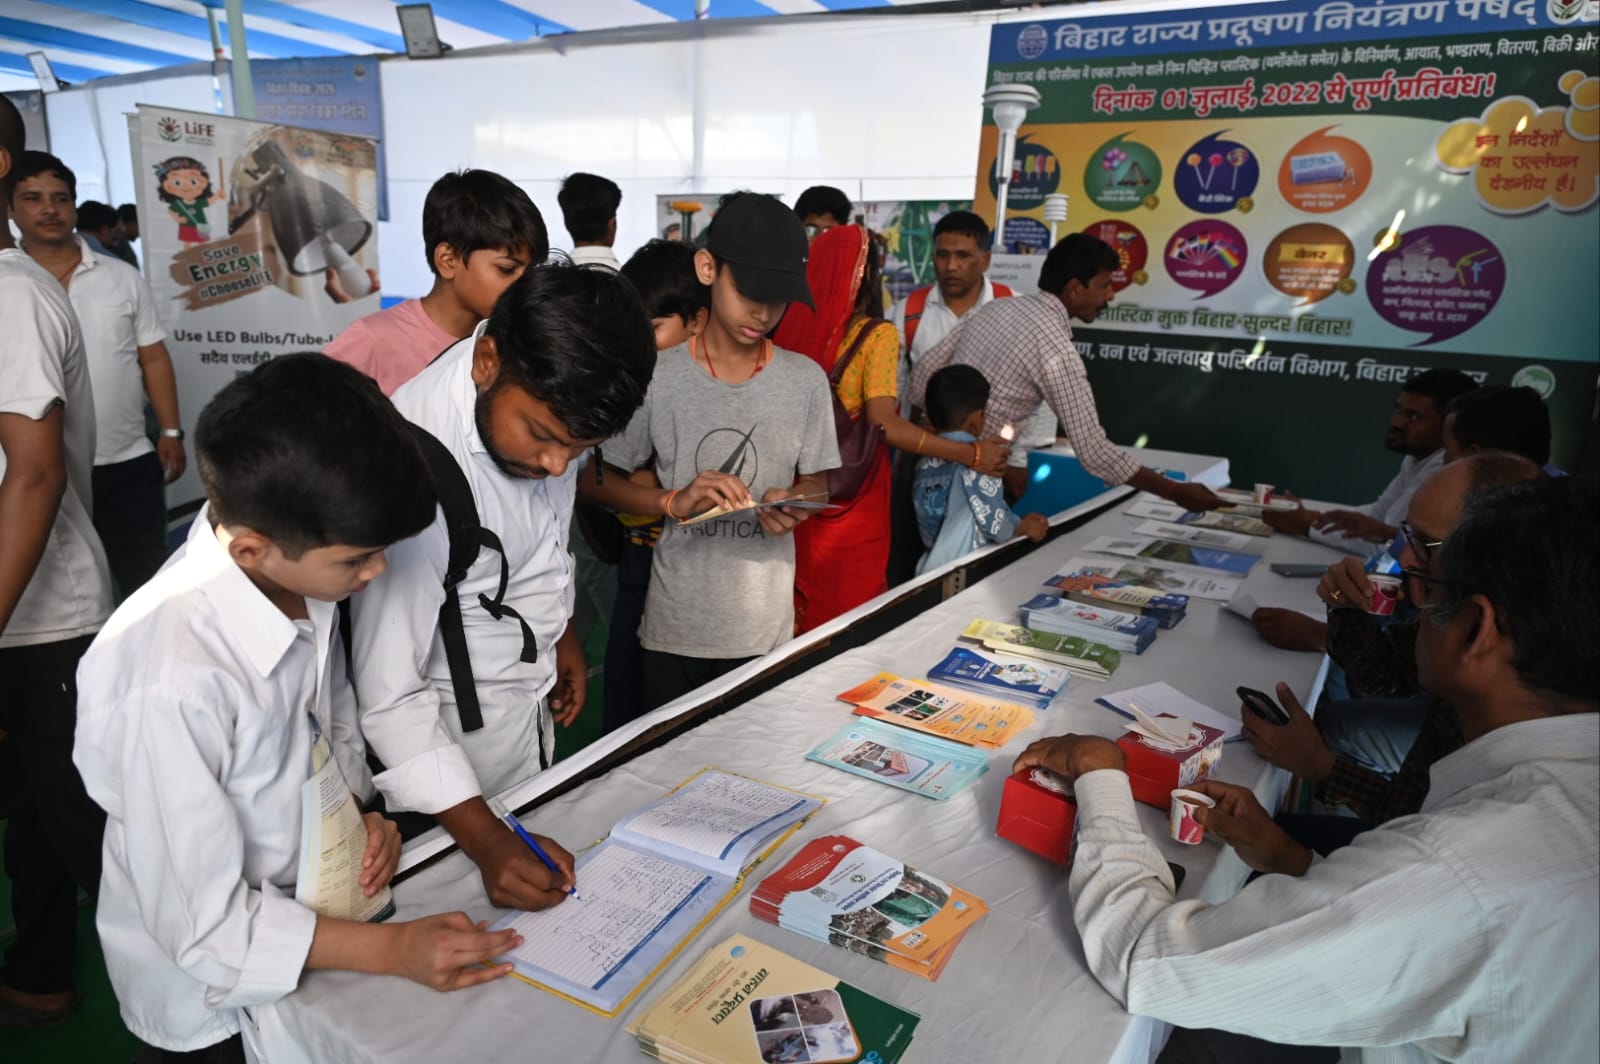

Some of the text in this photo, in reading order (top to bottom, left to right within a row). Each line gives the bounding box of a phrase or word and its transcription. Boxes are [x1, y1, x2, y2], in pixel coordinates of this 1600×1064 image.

[1054, 24, 1127, 51] बिहार
[1132, 20, 1202, 44] राज्य
[1208, 12, 1307, 46] प्रदूषण
[1313, 1, 1445, 32] नियंत्रण
[1220, 55, 1259, 72] प्लास्टिक
[1310, 48, 1339, 67] समेत)
[1341, 46, 1352, 64] के
[1354, 46, 1401, 64] विनिर्माण,
[1404, 45, 1442, 62] आयात,
[1446, 42, 1493, 59] भण्डारण,
[1497, 38, 1539, 56] वितरण,
[1575, 31, 1599, 51] और
[1093, 83, 1155, 113] दिनांक
[1161, 89, 1188, 109] 01
[1189, 78, 1257, 117] जुलाई,
[1260, 82, 1321, 106] 2022
[1324, 72, 1350, 102] से
[1350, 69, 1394, 110] पूर्ण
[1476, 134, 1500, 148] इन
[1481, 151, 1580, 169] का उल्लंघन
[1489, 172, 1547, 191] दंडनीय
[203, 245, 241, 261] Save
[188, 253, 262, 282] Energy
[1295, 313, 1353, 337] बिहार!
[174, 329, 203, 342] Use
[207, 331, 236, 343] LED
[200, 349, 229, 364] सदैव
[1099, 343, 1124, 360] वन
[1127, 343, 1150, 362] एवं
[1152, 346, 1213, 371] जलवायु
[1217, 349, 1284, 374] परिवर्तन
[1289, 353, 1350, 380] विभाग,
[1356, 358, 1410, 383] बिहार
